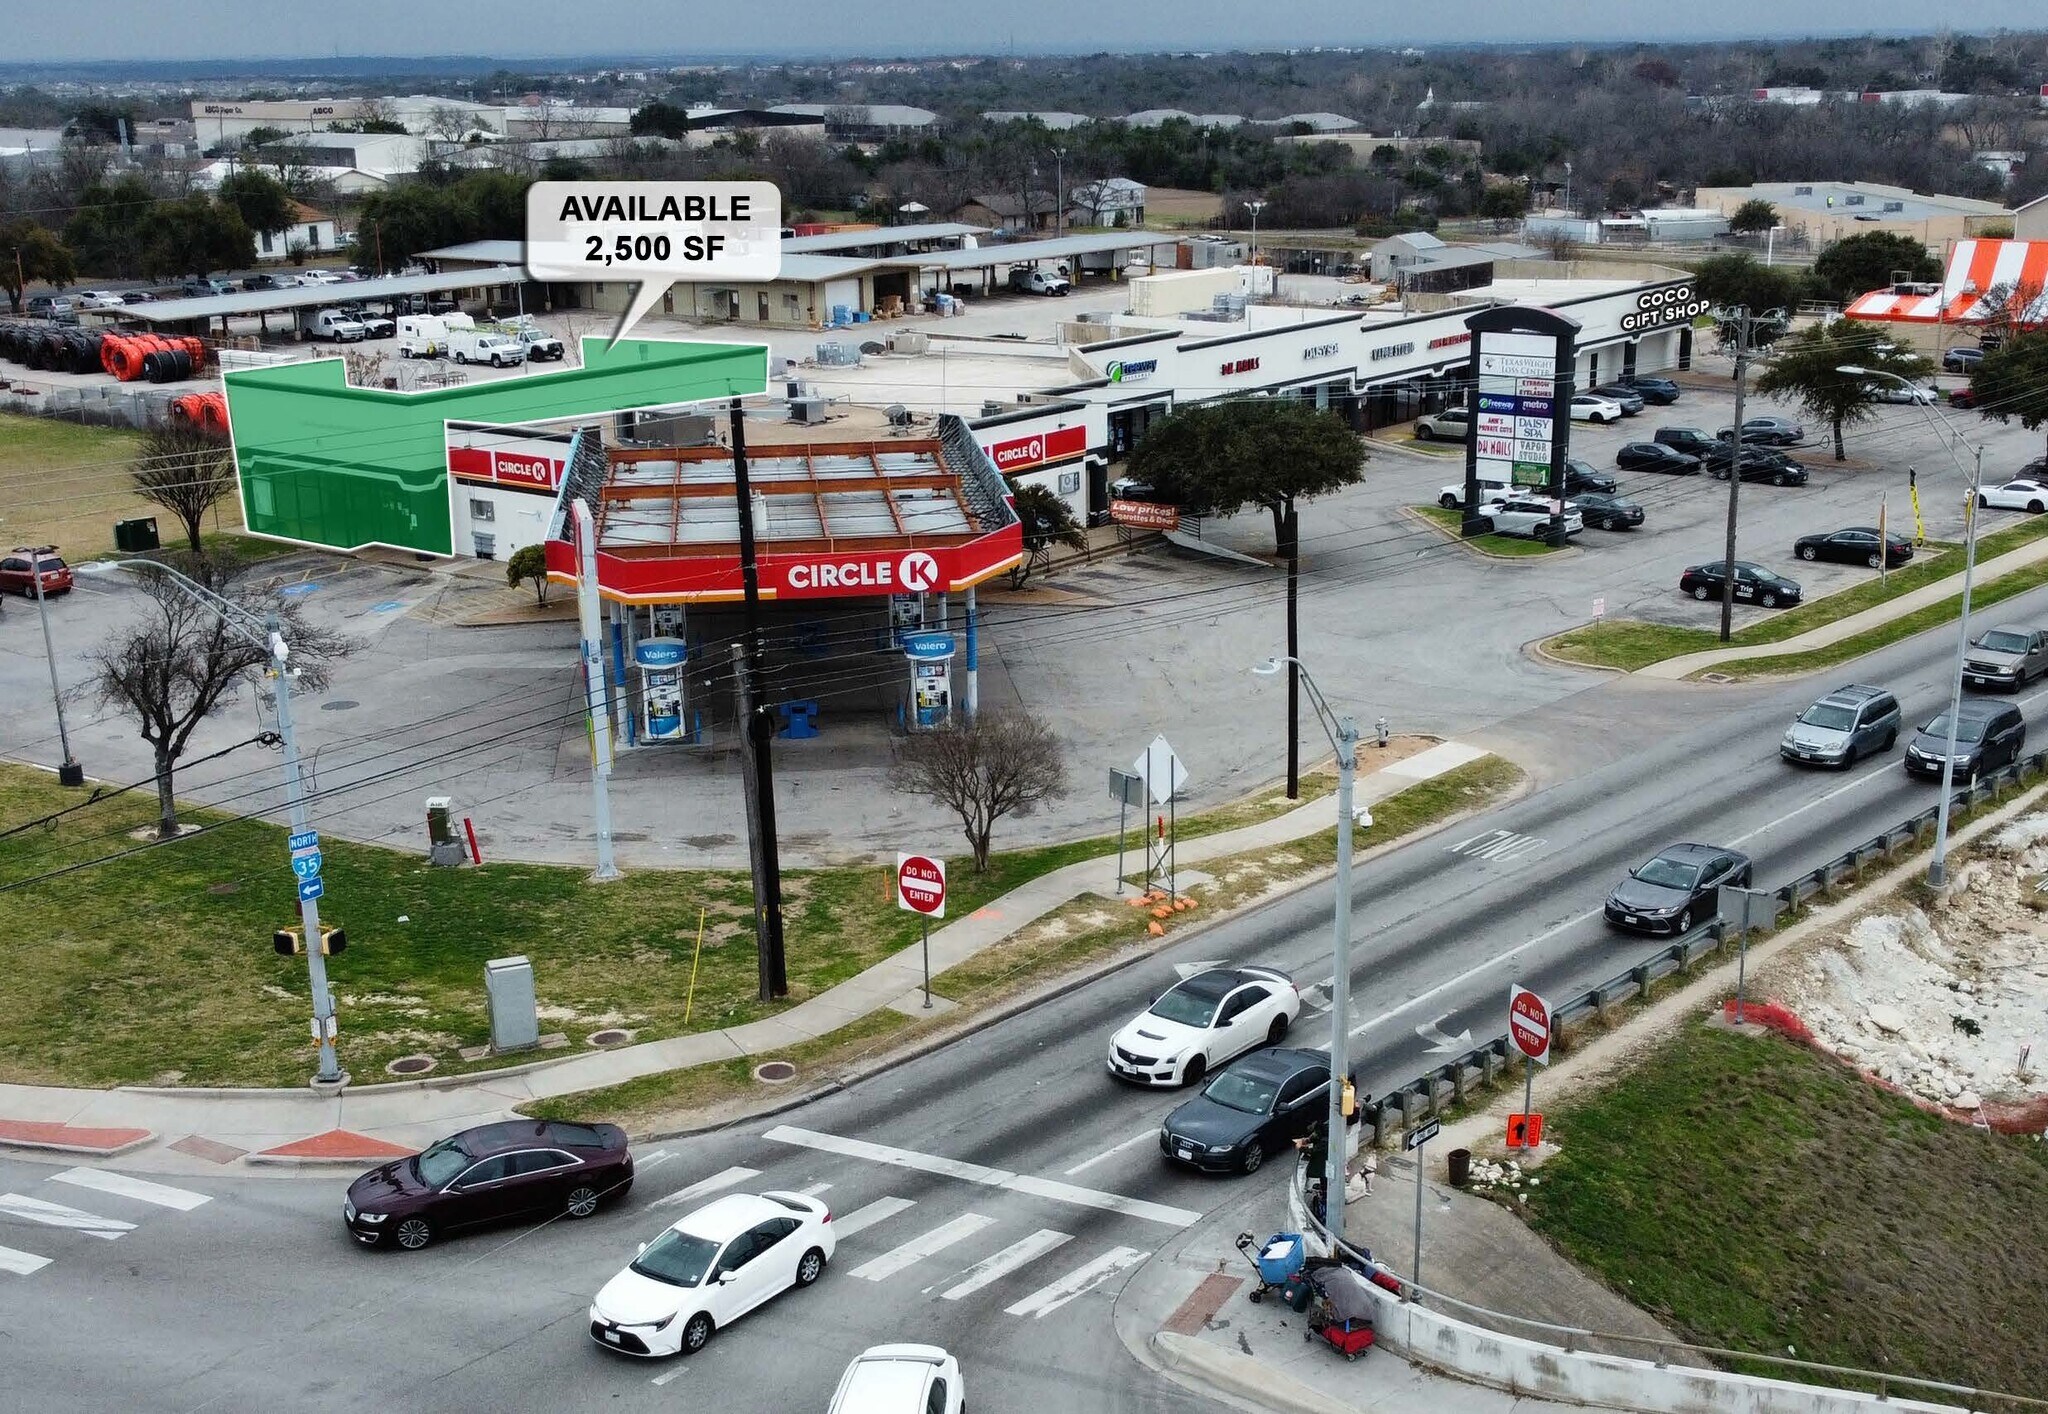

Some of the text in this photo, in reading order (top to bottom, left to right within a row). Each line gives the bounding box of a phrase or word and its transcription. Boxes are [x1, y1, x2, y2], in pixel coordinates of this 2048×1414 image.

[1120, 360, 1157, 374] Freeway
[1502, 358, 1553, 368] TEXAS WEIGHT
[1520, 367, 1550, 376] CENTER
[1488, 399, 1514, 410] Freeway
[1522, 400, 1548, 410] metro
[1519, 418, 1550, 428] DAISY
[1524, 428, 1543, 438] SPA
[998, 440, 1041, 462] CIRCLE K
[1490, 440, 1512, 456] NAILS
[1520, 441, 1547, 451] VAPOR
[1520, 452, 1548, 462] STUDIO
[498, 461, 546, 480] CIRCLE K
[1112, 502, 1175, 516] Low prices!
[1112, 512, 1149, 522] Cigarettes
[788, 552, 938, 591] CIRCLE K
[915, 642, 946, 650] Valero
[644, 651, 678, 659] Valero
[291, 833, 317, 848] NORTH
[1443, 828, 1548, 862] ONLY
[297, 858, 318, 876] 35
[906, 866, 938, 880] DO NOT
[910, 890, 934, 903] ENTER
[1517, 1000, 1544, 1022] DO NOT
[1518, 1028, 1540, 1048] ENTER
